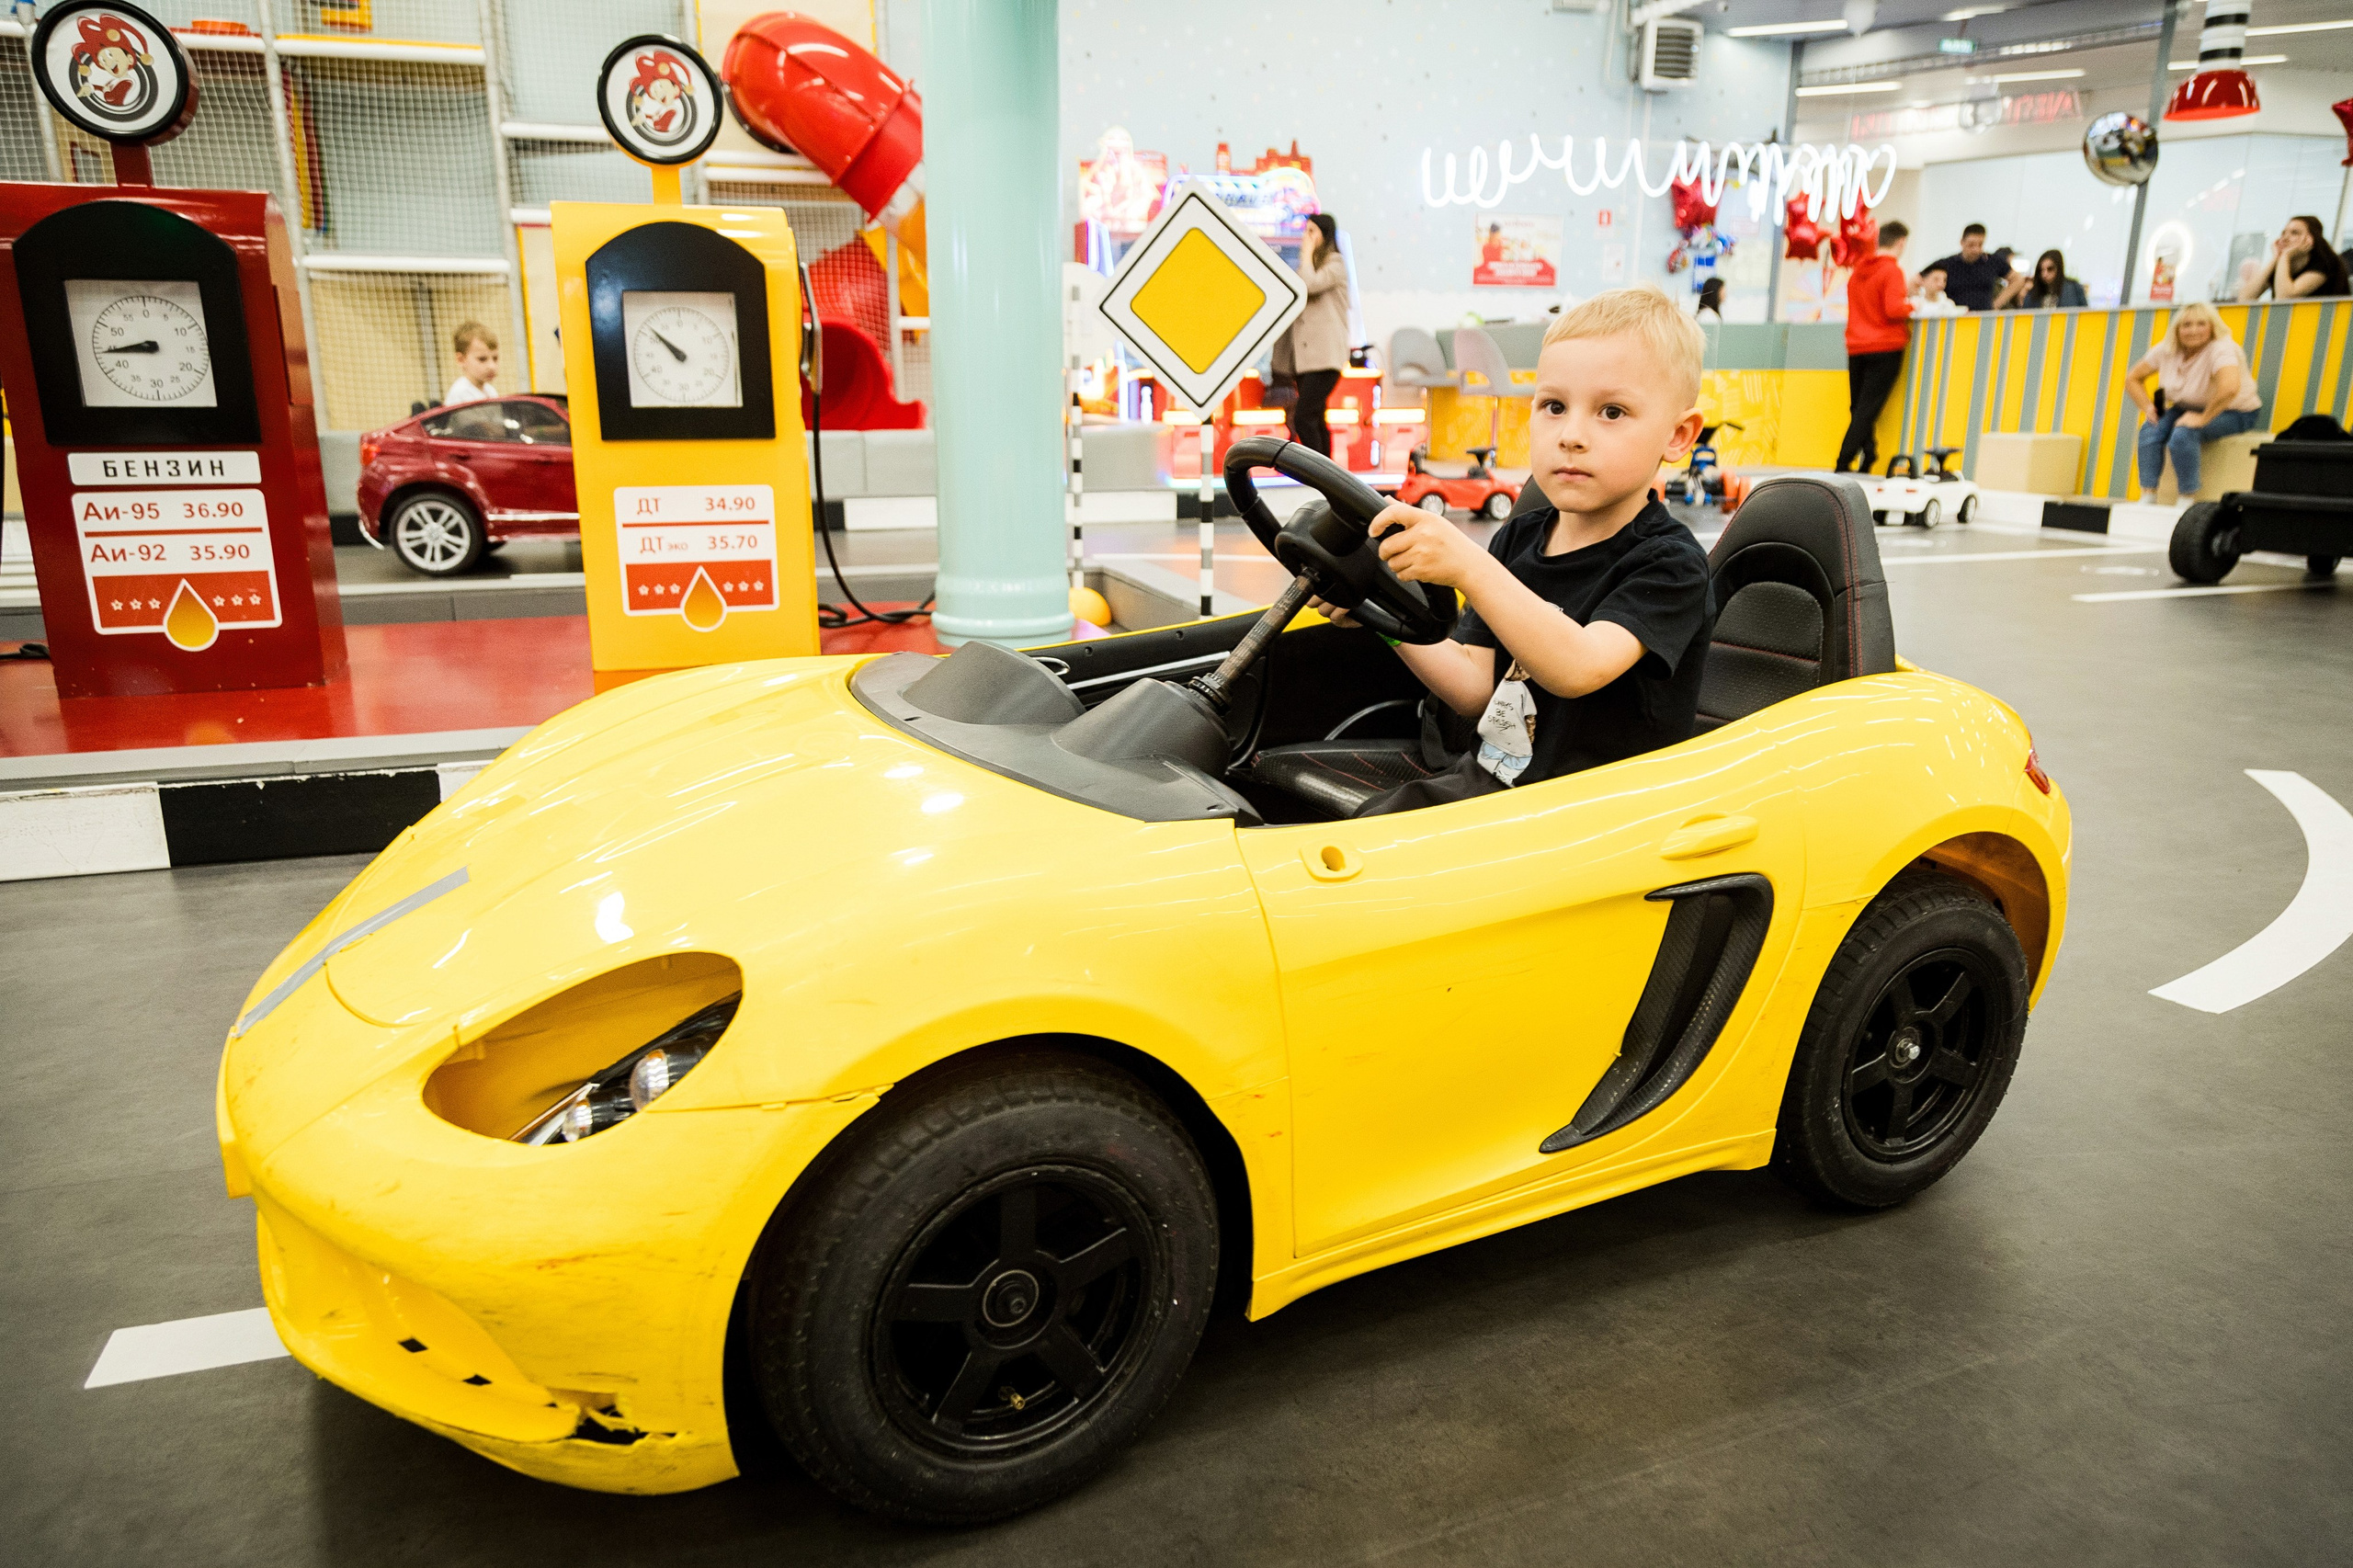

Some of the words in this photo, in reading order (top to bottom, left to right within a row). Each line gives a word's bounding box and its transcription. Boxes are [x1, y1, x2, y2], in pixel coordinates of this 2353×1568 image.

[123, 313, 134, 322] 55
[142, 309, 150, 319] 0
[110, 327, 124, 336] 50
[175, 327, 188, 337] 10
[115, 359, 129, 369] 40
[179, 361, 193, 371] 20
[131, 374, 142, 382] 35
[170, 375, 181, 383] 25
[150, 379, 164, 388] 30
[103, 460, 224, 478] БЕНЗИН
[637, 497, 661, 515] ДТ
[706, 497, 756, 511] 34.90
[84, 502, 160, 521] Аи-95
[183, 502, 244, 517] 36.90
[640, 537, 664, 553] ДТ
[708, 535, 758, 550] 35.70
[90, 543, 166, 562] Аи-92
[189, 544, 250, 561] 35.90
[1496, 709, 1506, 717] BE
